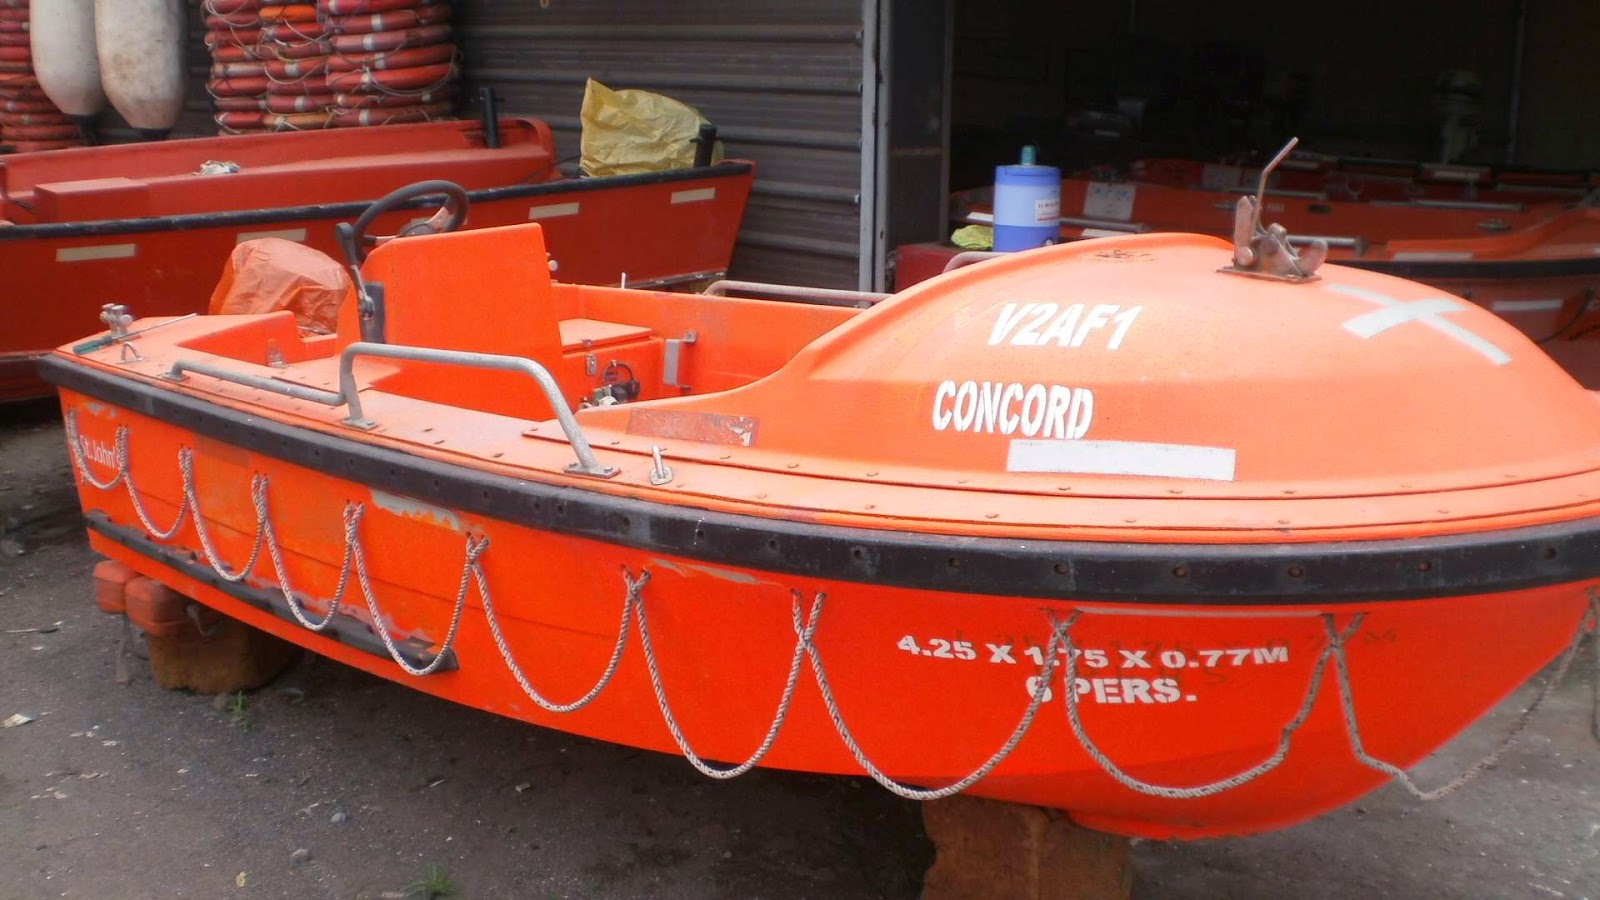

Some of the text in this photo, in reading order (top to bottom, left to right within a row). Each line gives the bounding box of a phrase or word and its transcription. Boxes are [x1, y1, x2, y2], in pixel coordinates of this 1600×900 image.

[987, 303, 1144, 350] V2AF1
[932, 379, 1094, 440] CONCORD
[897, 635, 976, 660] 4.25
[985, 643, 1017, 664] X
[1119, 650, 1151, 668] X
[1160, 647, 1289, 668] 0.77M
